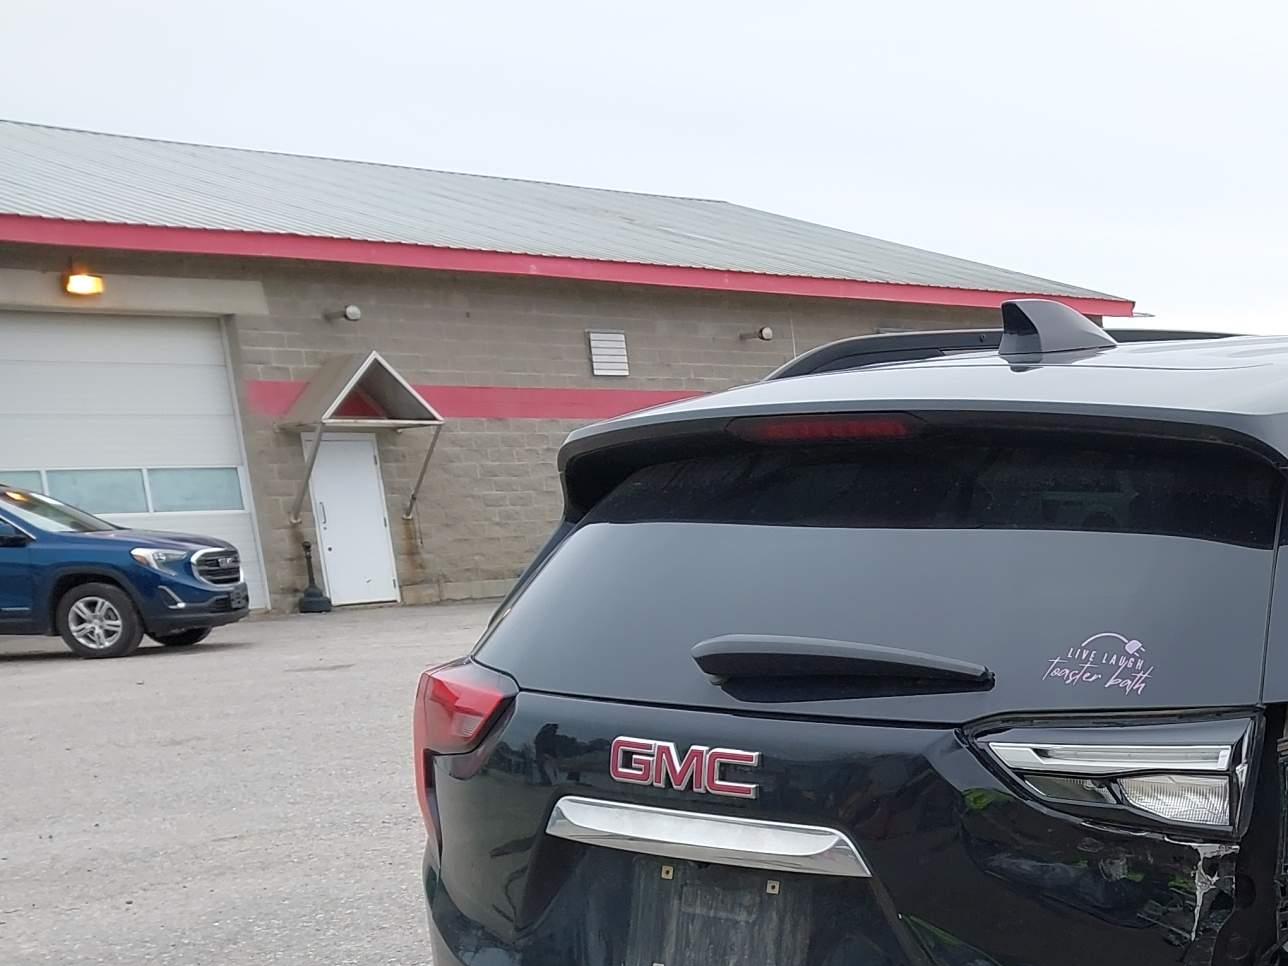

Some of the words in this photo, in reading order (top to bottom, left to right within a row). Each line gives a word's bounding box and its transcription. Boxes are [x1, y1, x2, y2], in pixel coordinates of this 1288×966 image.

[1067, 647, 1097, 662] LIVE
[1102, 652, 1144, 670] LAUGH
[1104, 660, 1153, 695] bath
[610, 736, 760, 799] GMC
